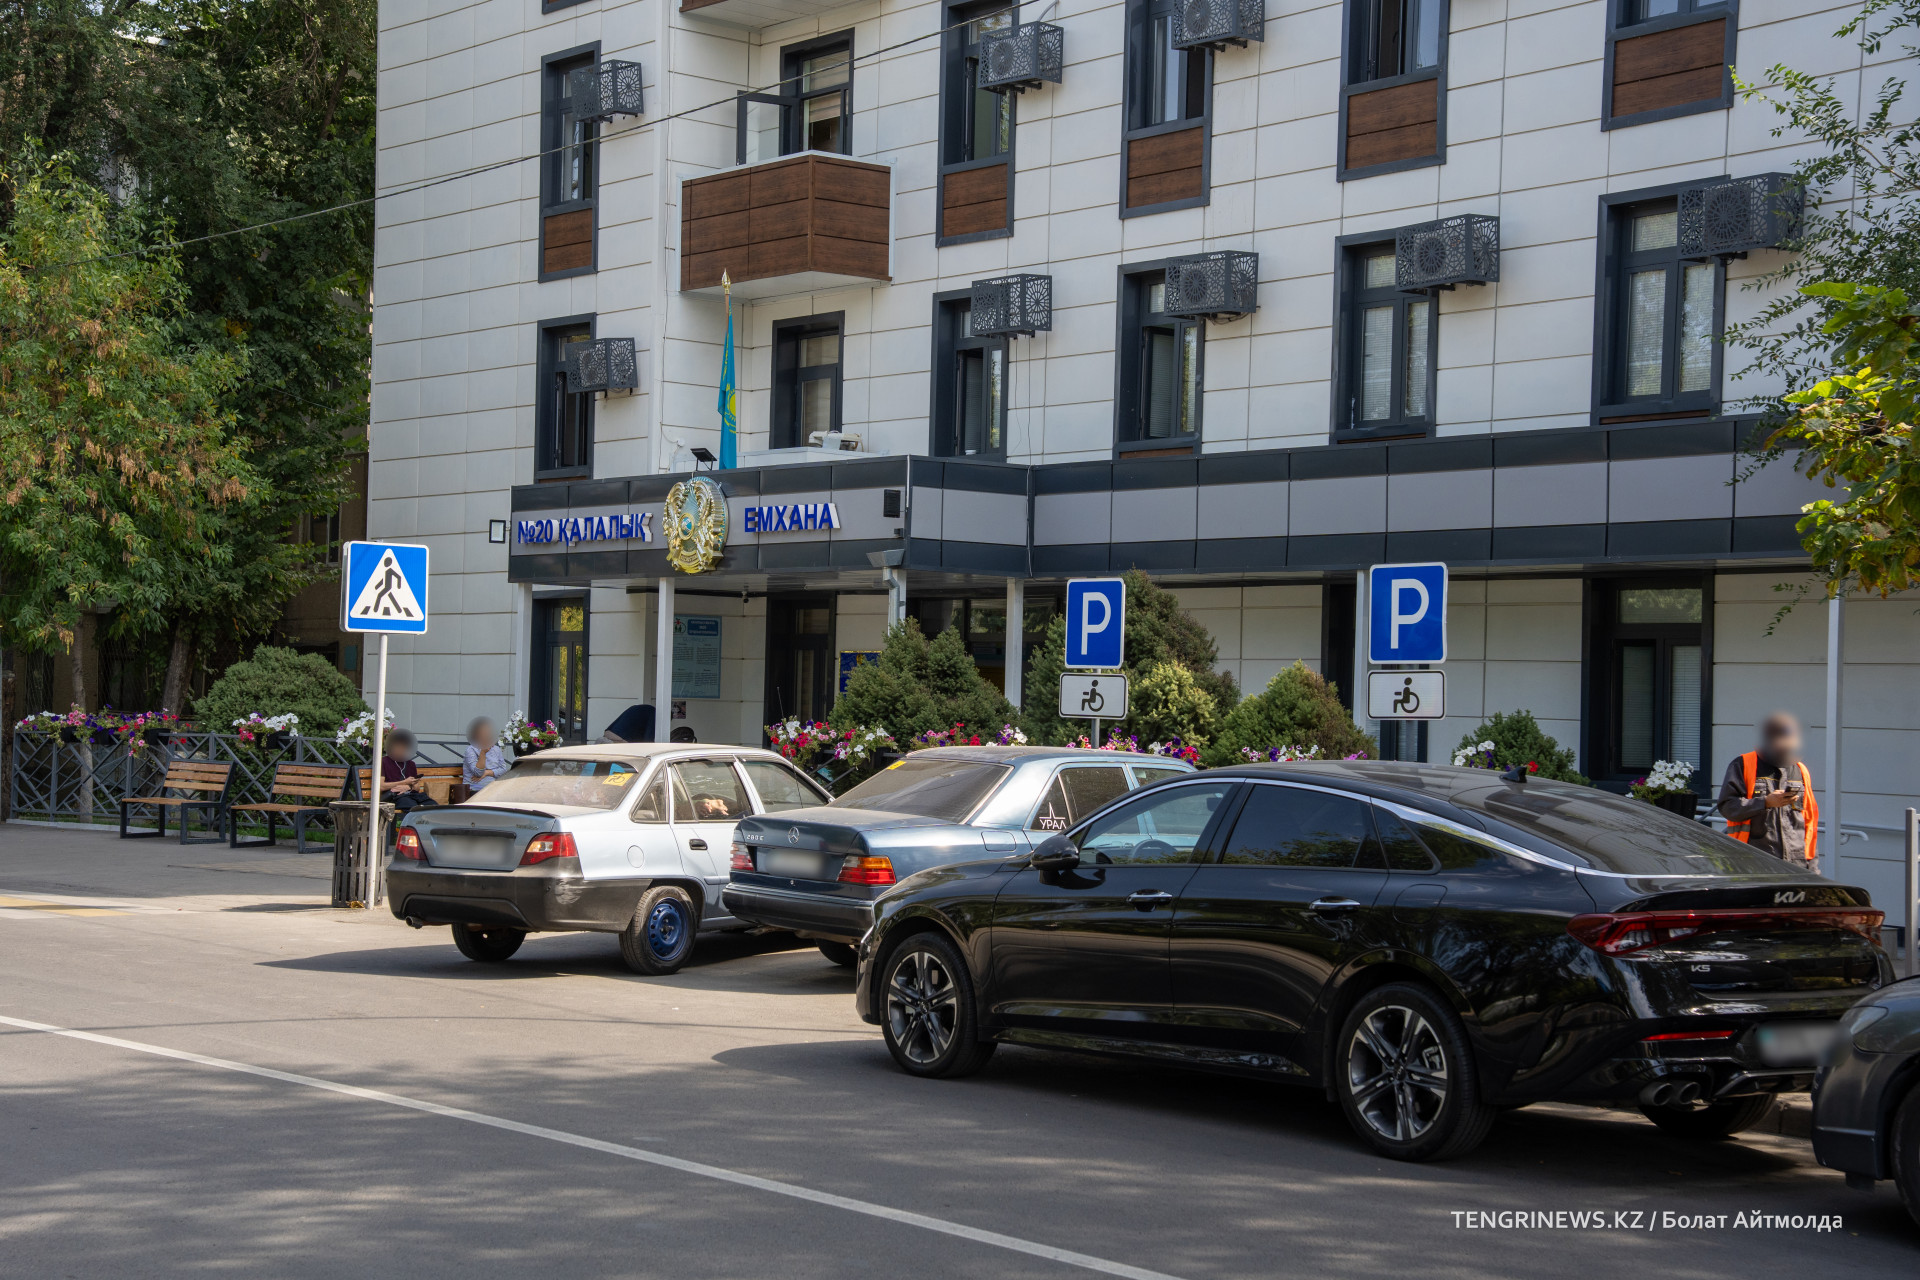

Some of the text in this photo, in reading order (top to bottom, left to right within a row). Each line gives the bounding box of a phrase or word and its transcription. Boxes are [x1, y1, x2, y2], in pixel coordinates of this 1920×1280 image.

[518, 503, 835, 547] №20 ҚАЛАЛЫҚ ЕМХАНА
[1080, 591, 1112, 656] P
[1390, 578, 1430, 650] P
[1039, 819, 1067, 830] УРАЛ
[1774, 891, 1806, 903] KIA
[1691, 964, 1711, 972] K5
